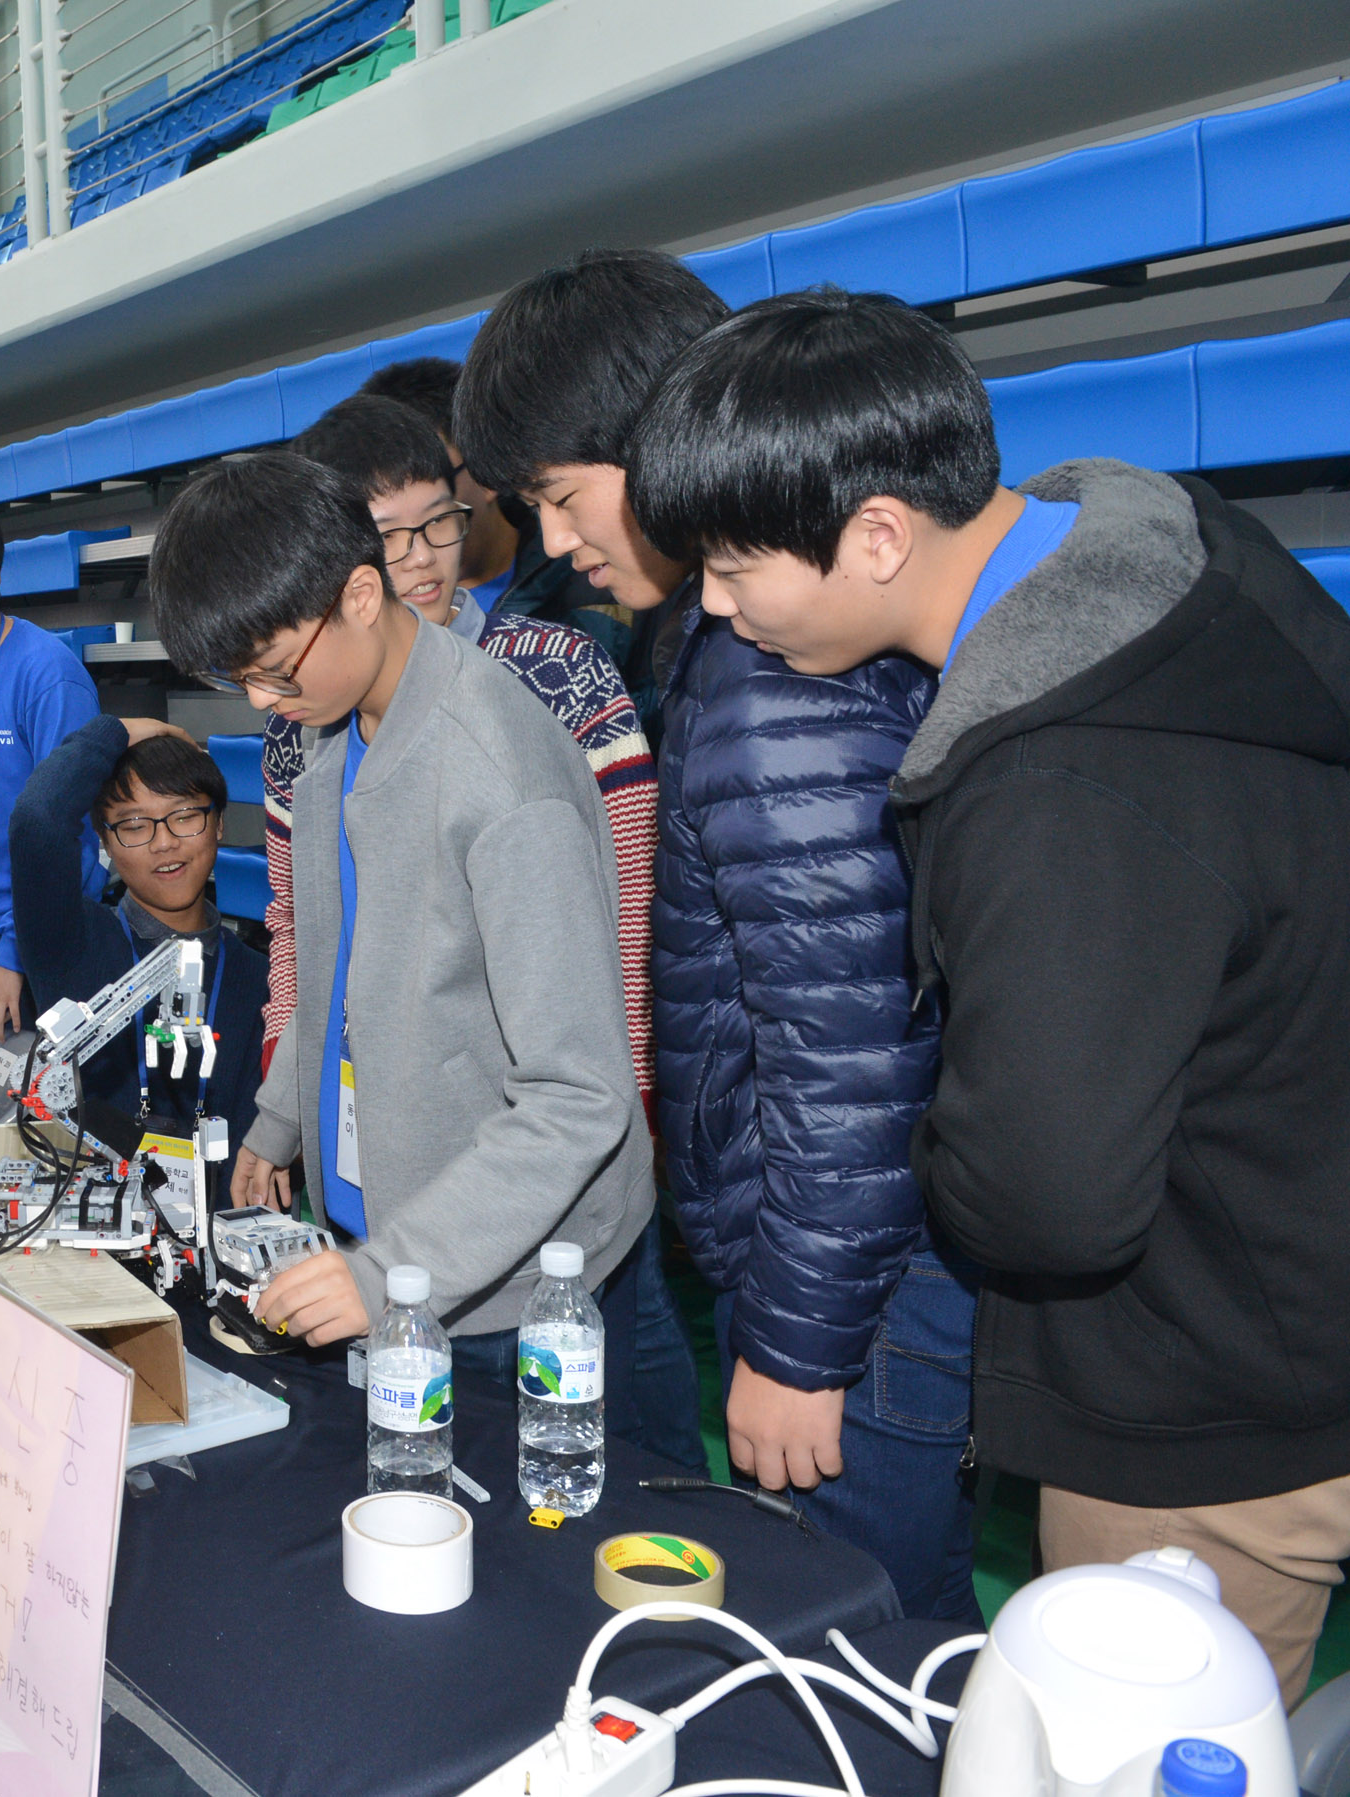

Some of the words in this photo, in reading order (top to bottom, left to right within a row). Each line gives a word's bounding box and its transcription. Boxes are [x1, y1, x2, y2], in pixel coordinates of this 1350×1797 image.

[165, 1166, 190, 1179] 등학교
[564, 1360, 596, 1374] 스파클
[370, 1383, 418, 1409] 스파클
